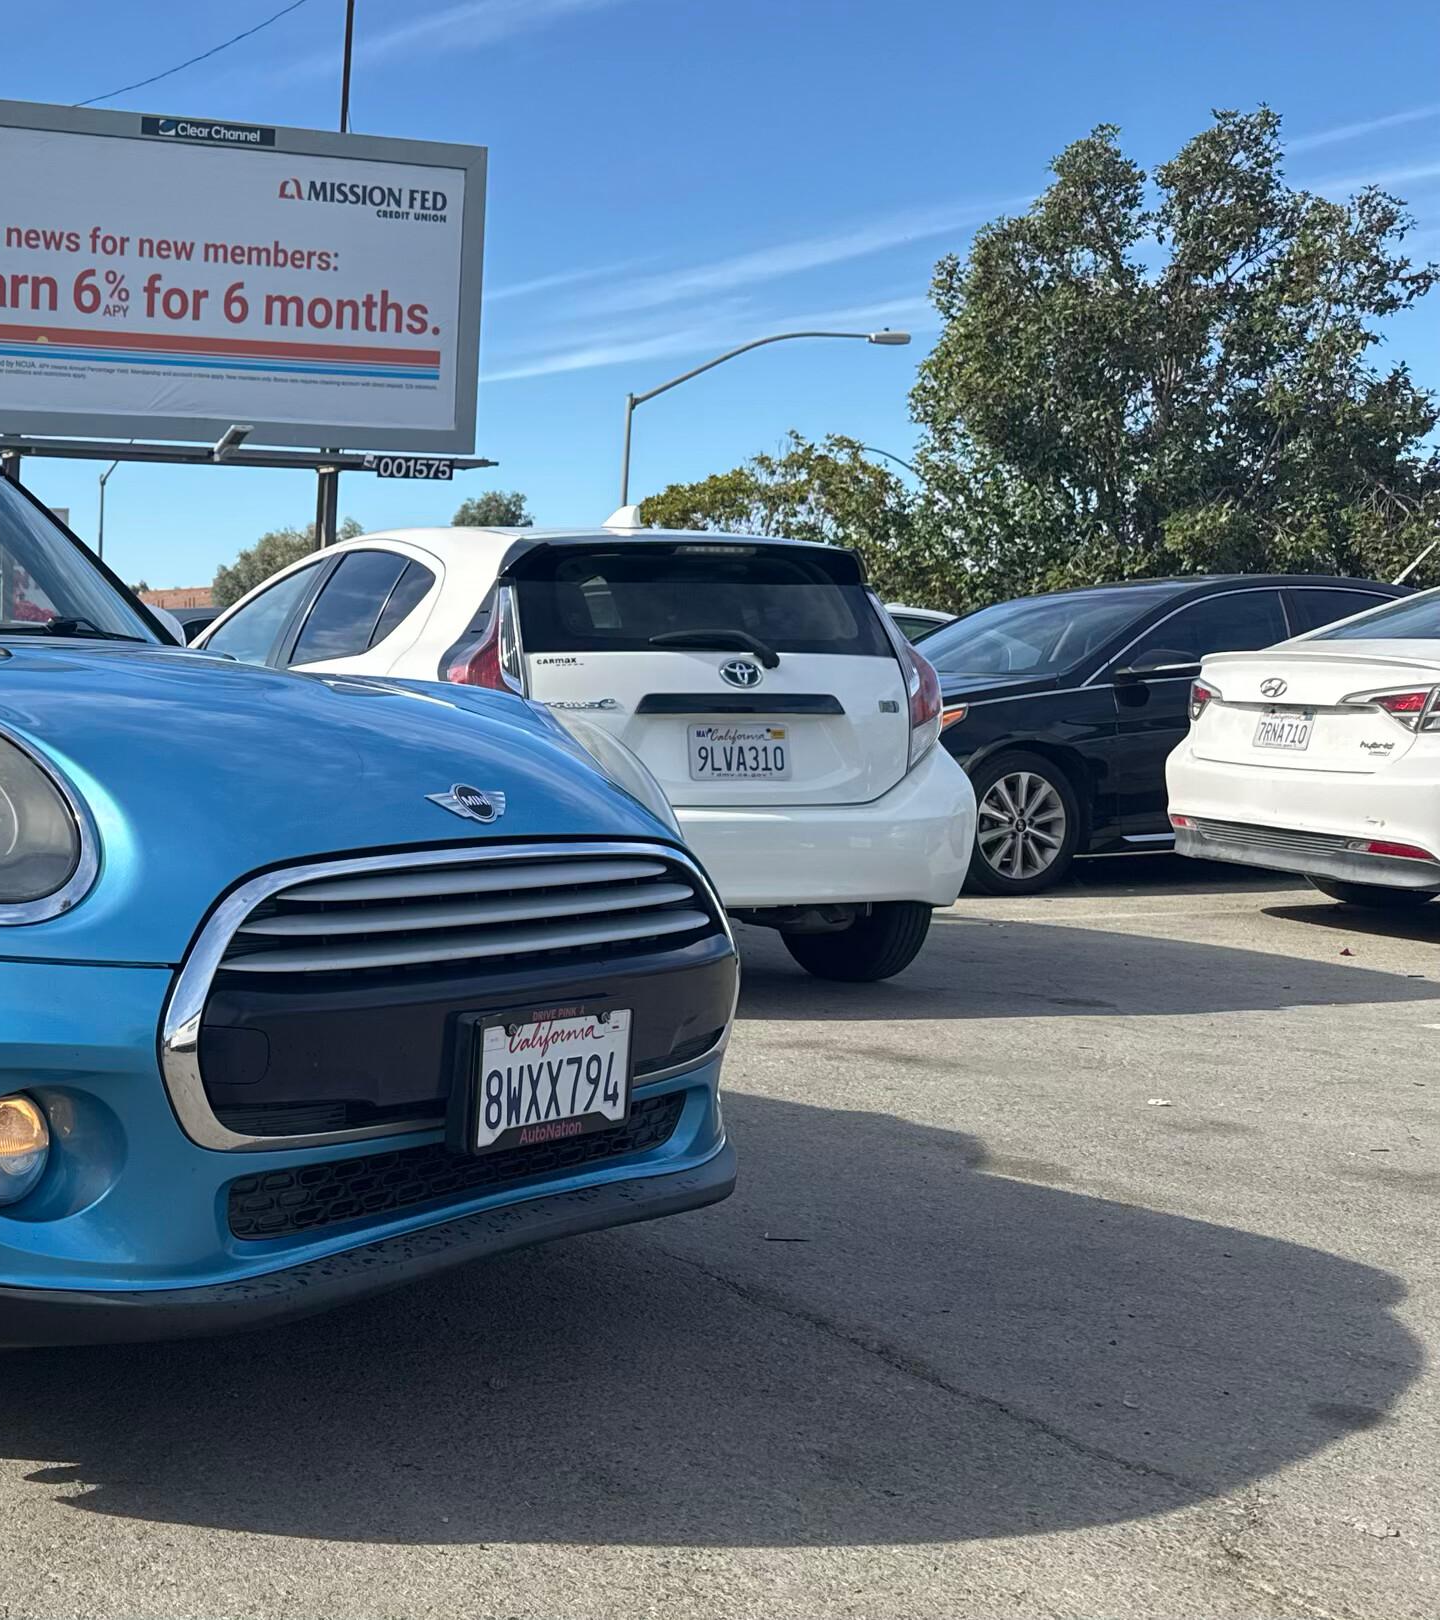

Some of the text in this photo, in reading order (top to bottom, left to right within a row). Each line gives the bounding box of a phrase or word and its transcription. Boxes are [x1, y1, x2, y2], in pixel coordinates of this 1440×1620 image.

[177, 122, 260, 142] Clear Channel
[307, 180, 447, 212] MISSION FED
[376, 209, 447, 223] CREDIT UNION
[6, 226, 81, 252] news
[89, 226, 130, 256] for
[138, 237, 195, 261] new
[203, 240, 339, 272] members:
[102, 303, 130, 318] APY
[143, 273, 209, 321] for
[223, 281, 249, 324] 6
[264, 289, 441, 336] months.
[6, 359, 15, 368] by
[380, 458, 450, 479] 001575
[710, 728, 773, 745] California
[1258, 721, 1308, 744] 7RNA710
[698, 746, 785, 772] 9LVA310
[532, 1007, 577, 1022] DRIVE PINK
[509, 1020, 605, 1057] California
[485, 1051, 619, 1130] 8WXX794
[519, 1120, 582, 1144] AutoNation
